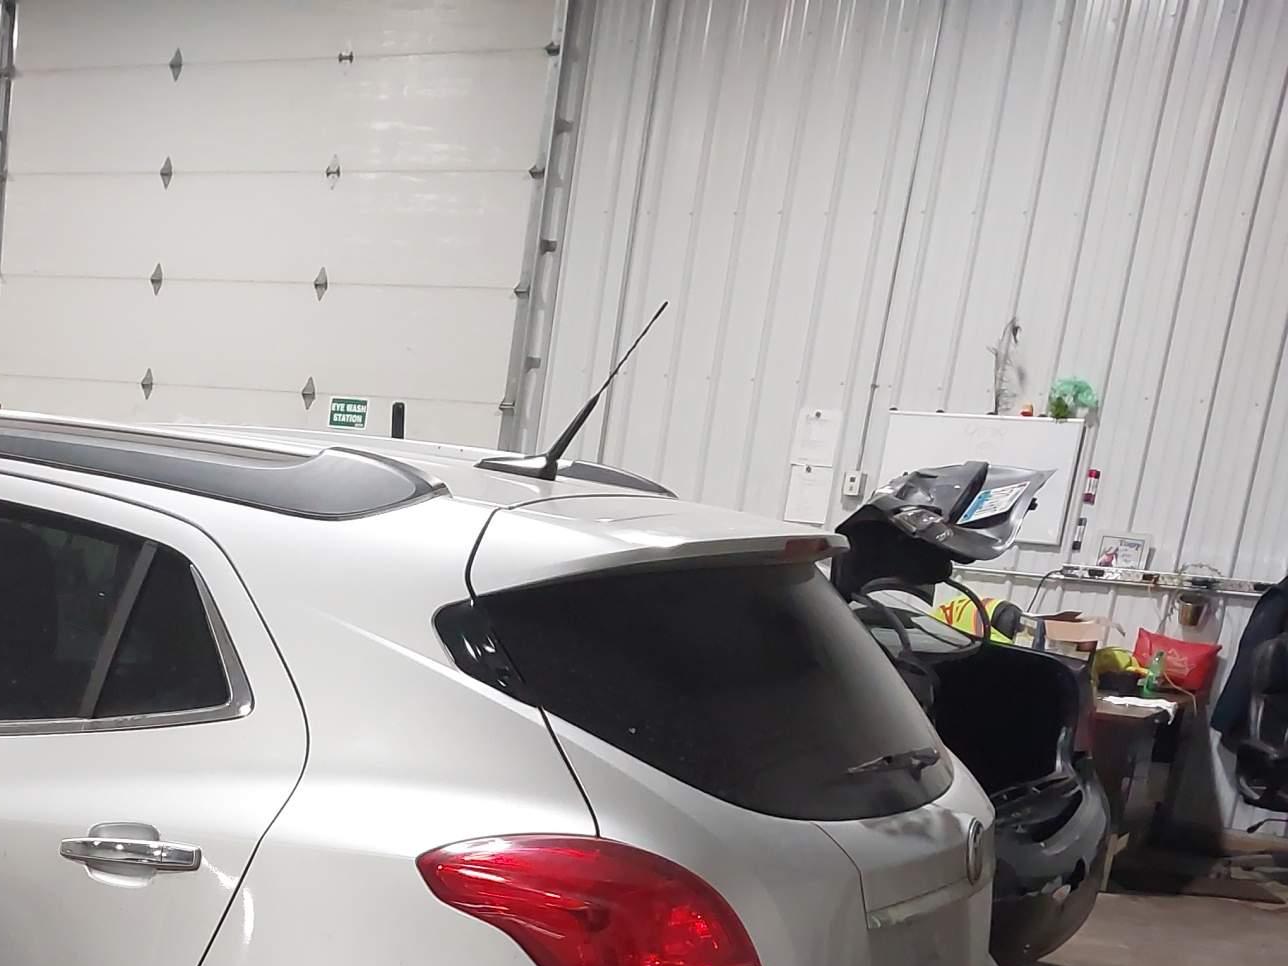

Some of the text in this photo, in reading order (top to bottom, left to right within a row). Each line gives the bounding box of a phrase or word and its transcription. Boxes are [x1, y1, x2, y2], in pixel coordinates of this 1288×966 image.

[331, 402, 367, 413] EYE WASH
[333, 413, 363, 423] STATION
